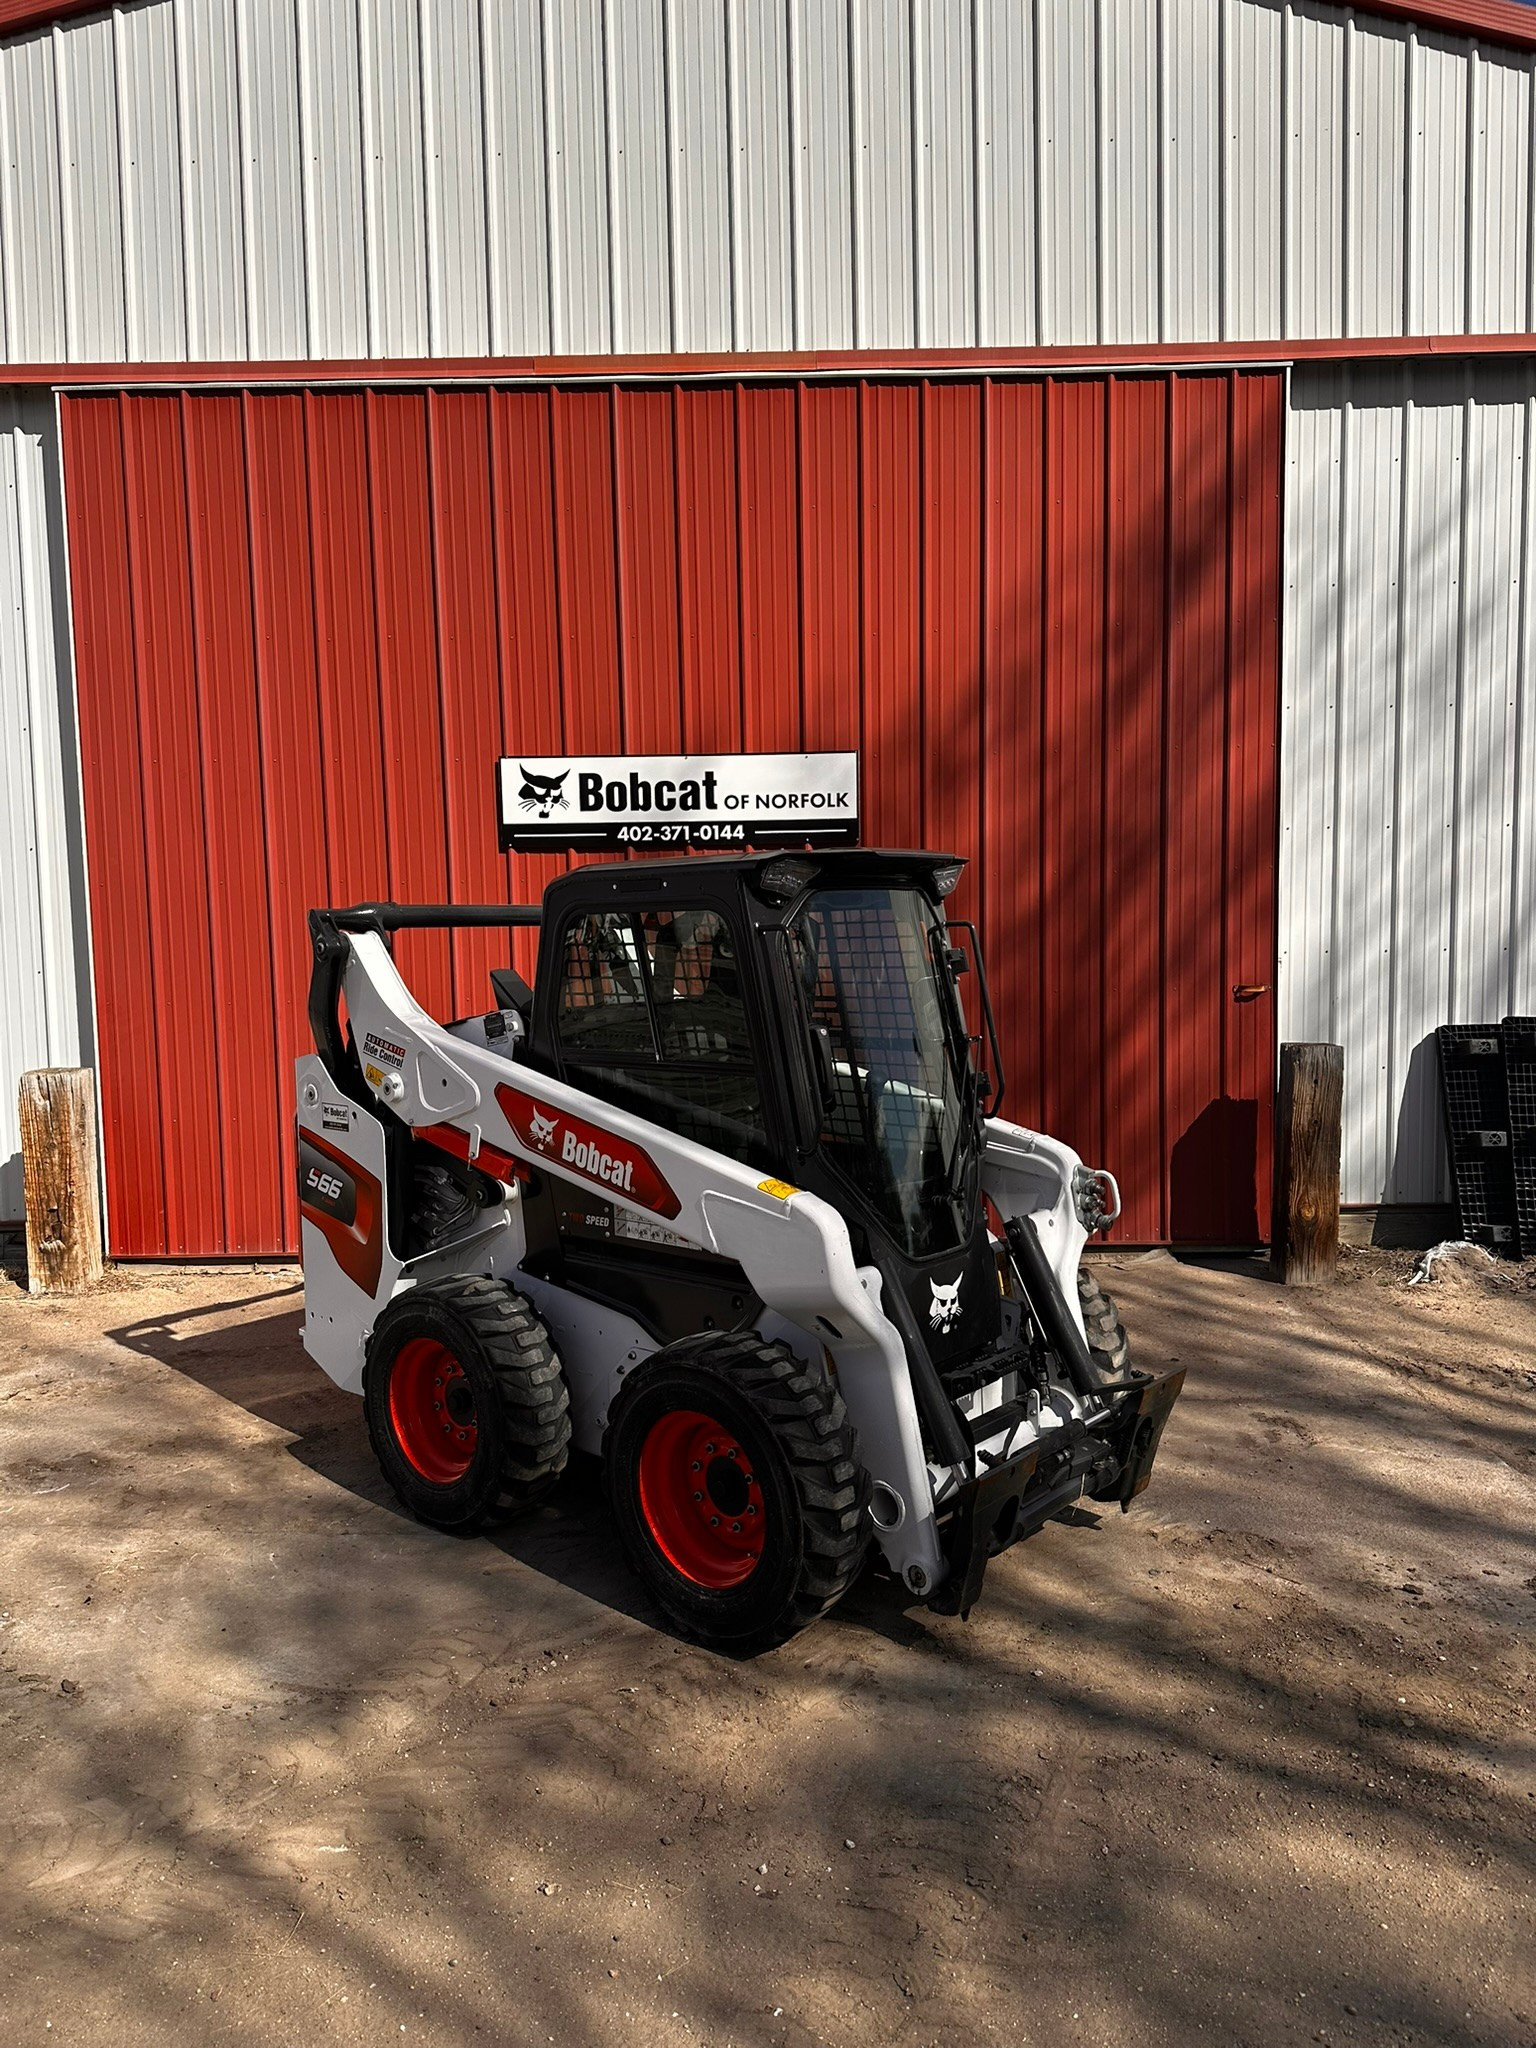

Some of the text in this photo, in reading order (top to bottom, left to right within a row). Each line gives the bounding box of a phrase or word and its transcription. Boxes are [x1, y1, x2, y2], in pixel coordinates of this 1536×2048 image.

[579, 771, 849, 812] Bobcat OF NORFOLK
[617, 824, 745, 841] 402-371-0144
[363, 1041, 404, 1068] Ride Control
[367, 1033, 405, 1057] AUTOMATIC
[562, 1129, 633, 1192] Bobcat
[306, 1167, 344, 1199] S66
[585, 1214, 610, 1227] SPEED
